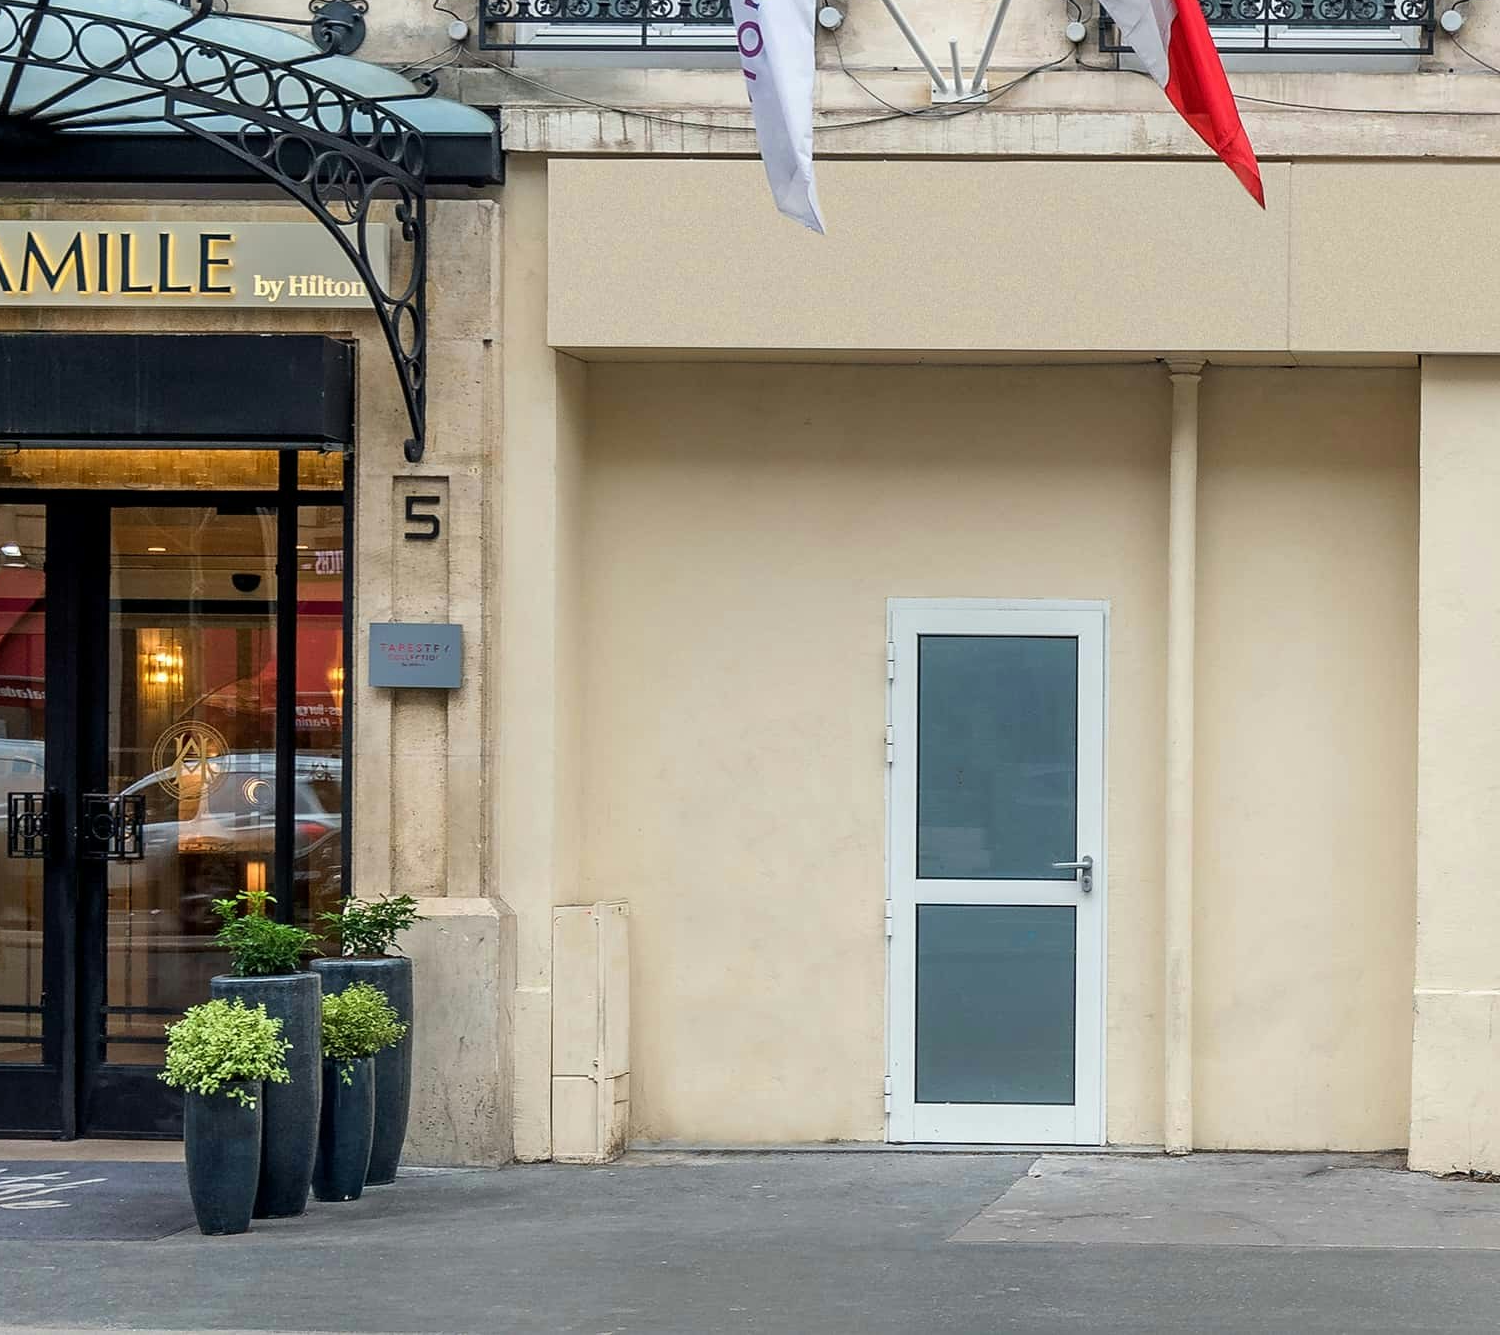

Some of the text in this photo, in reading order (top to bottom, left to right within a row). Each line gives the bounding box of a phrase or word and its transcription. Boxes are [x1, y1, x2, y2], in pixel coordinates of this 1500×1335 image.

[252, 274, 285, 303] by
[287, 274, 367, 298] Hilton
[403, 495, 441, 541] 5
